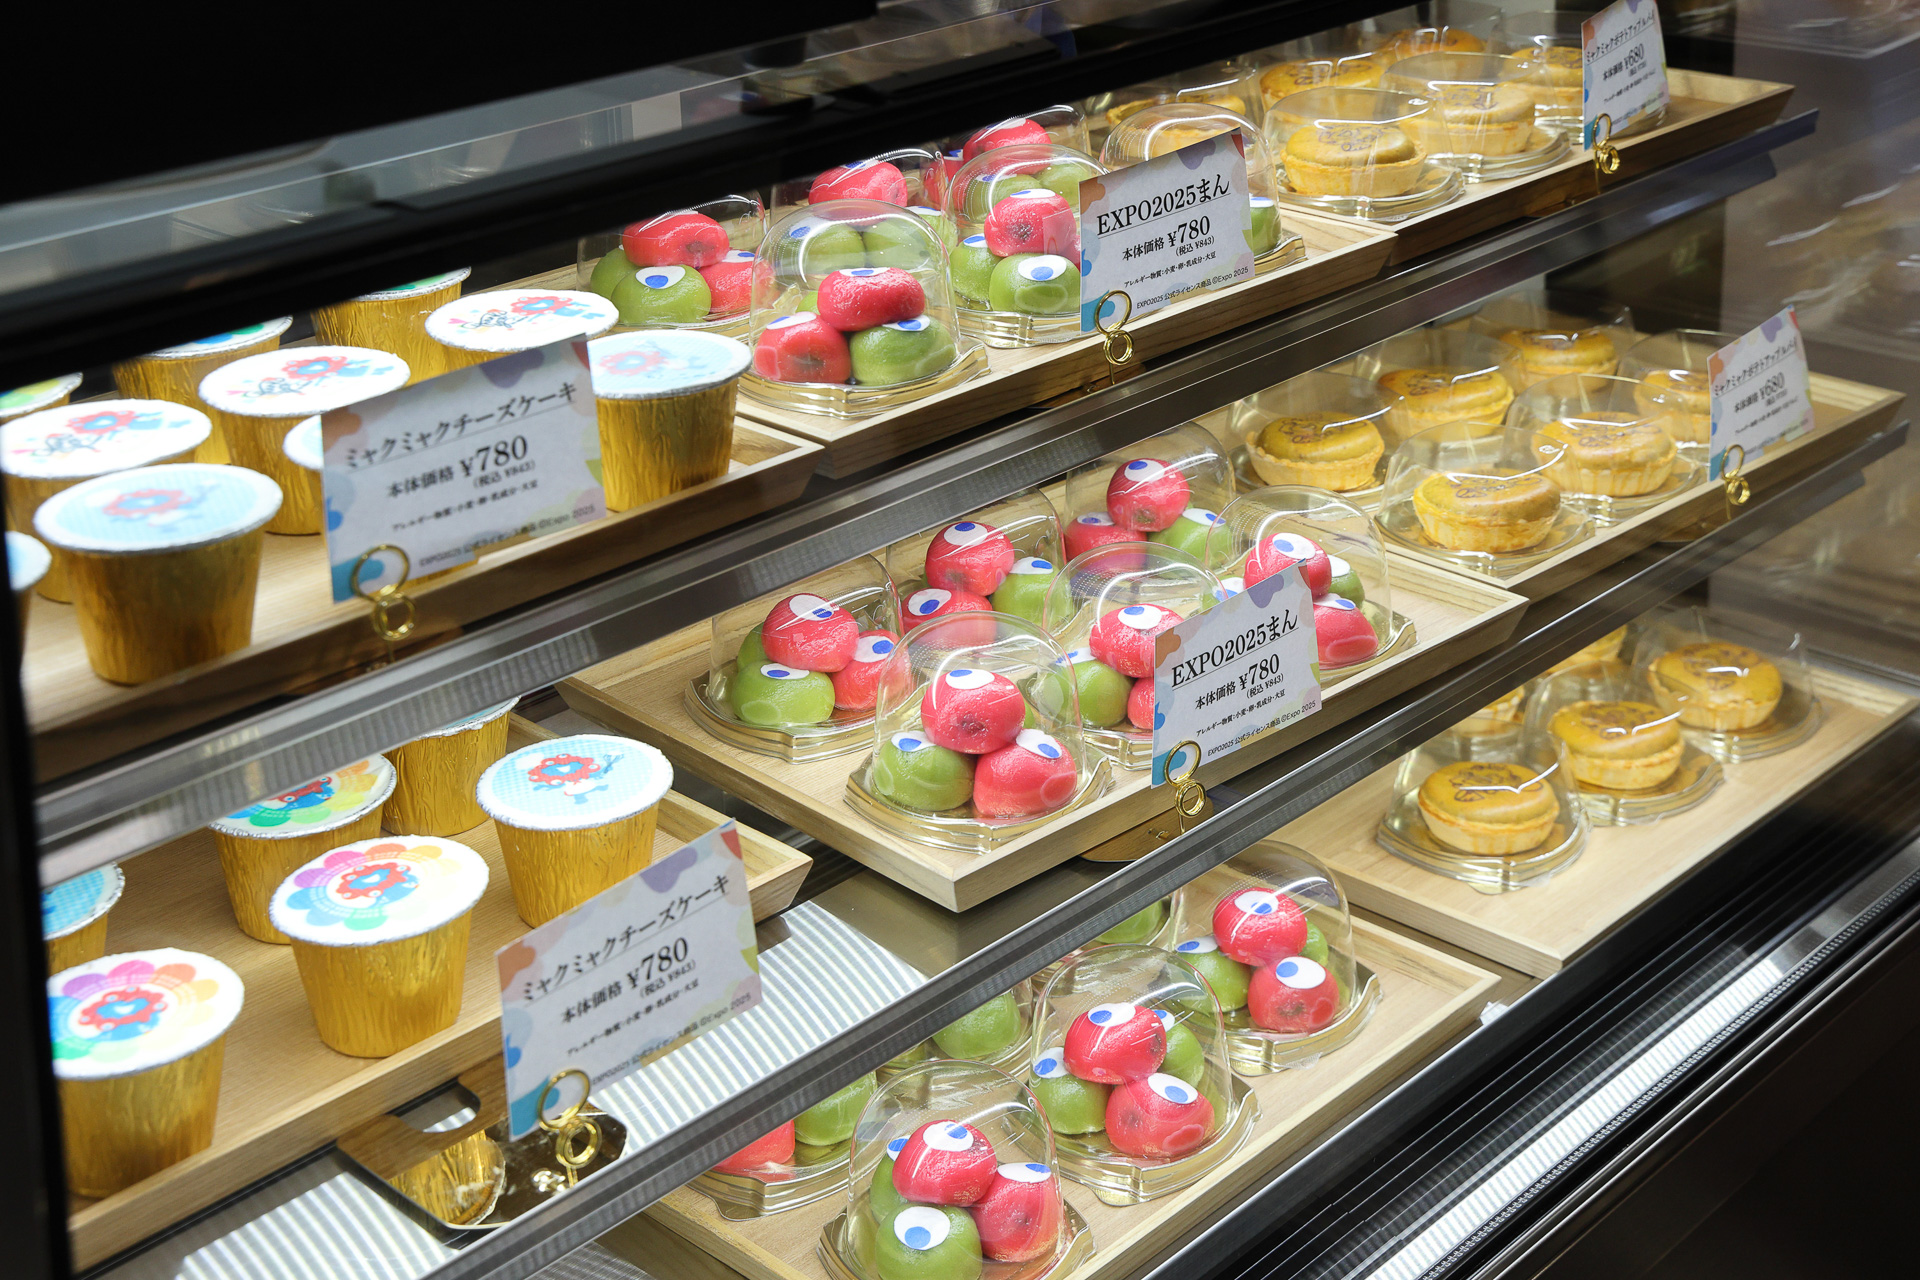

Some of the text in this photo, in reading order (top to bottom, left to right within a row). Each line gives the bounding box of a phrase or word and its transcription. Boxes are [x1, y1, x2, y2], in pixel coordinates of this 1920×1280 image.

[1097, 174, 1230, 236] EXPO2025まん
[1122, 215, 1211, 261] 本体価格 ¥780
[1136, 296, 1163, 309] EXPO2025
[345, 381, 577, 469] ミャクミャクチーズケーキ
[387, 435, 528, 498] 本体価格 ¥780
[1171, 609, 1298, 688] EXPO2025まん
[1194, 653, 1280, 710] 本体価格 ¥780
[1207, 739, 1234, 757] EXPO2025
[523, 874, 729, 1001] ミャクミャクチーズケーキ
[561, 937, 688, 1025] 本体価格 ¥780
